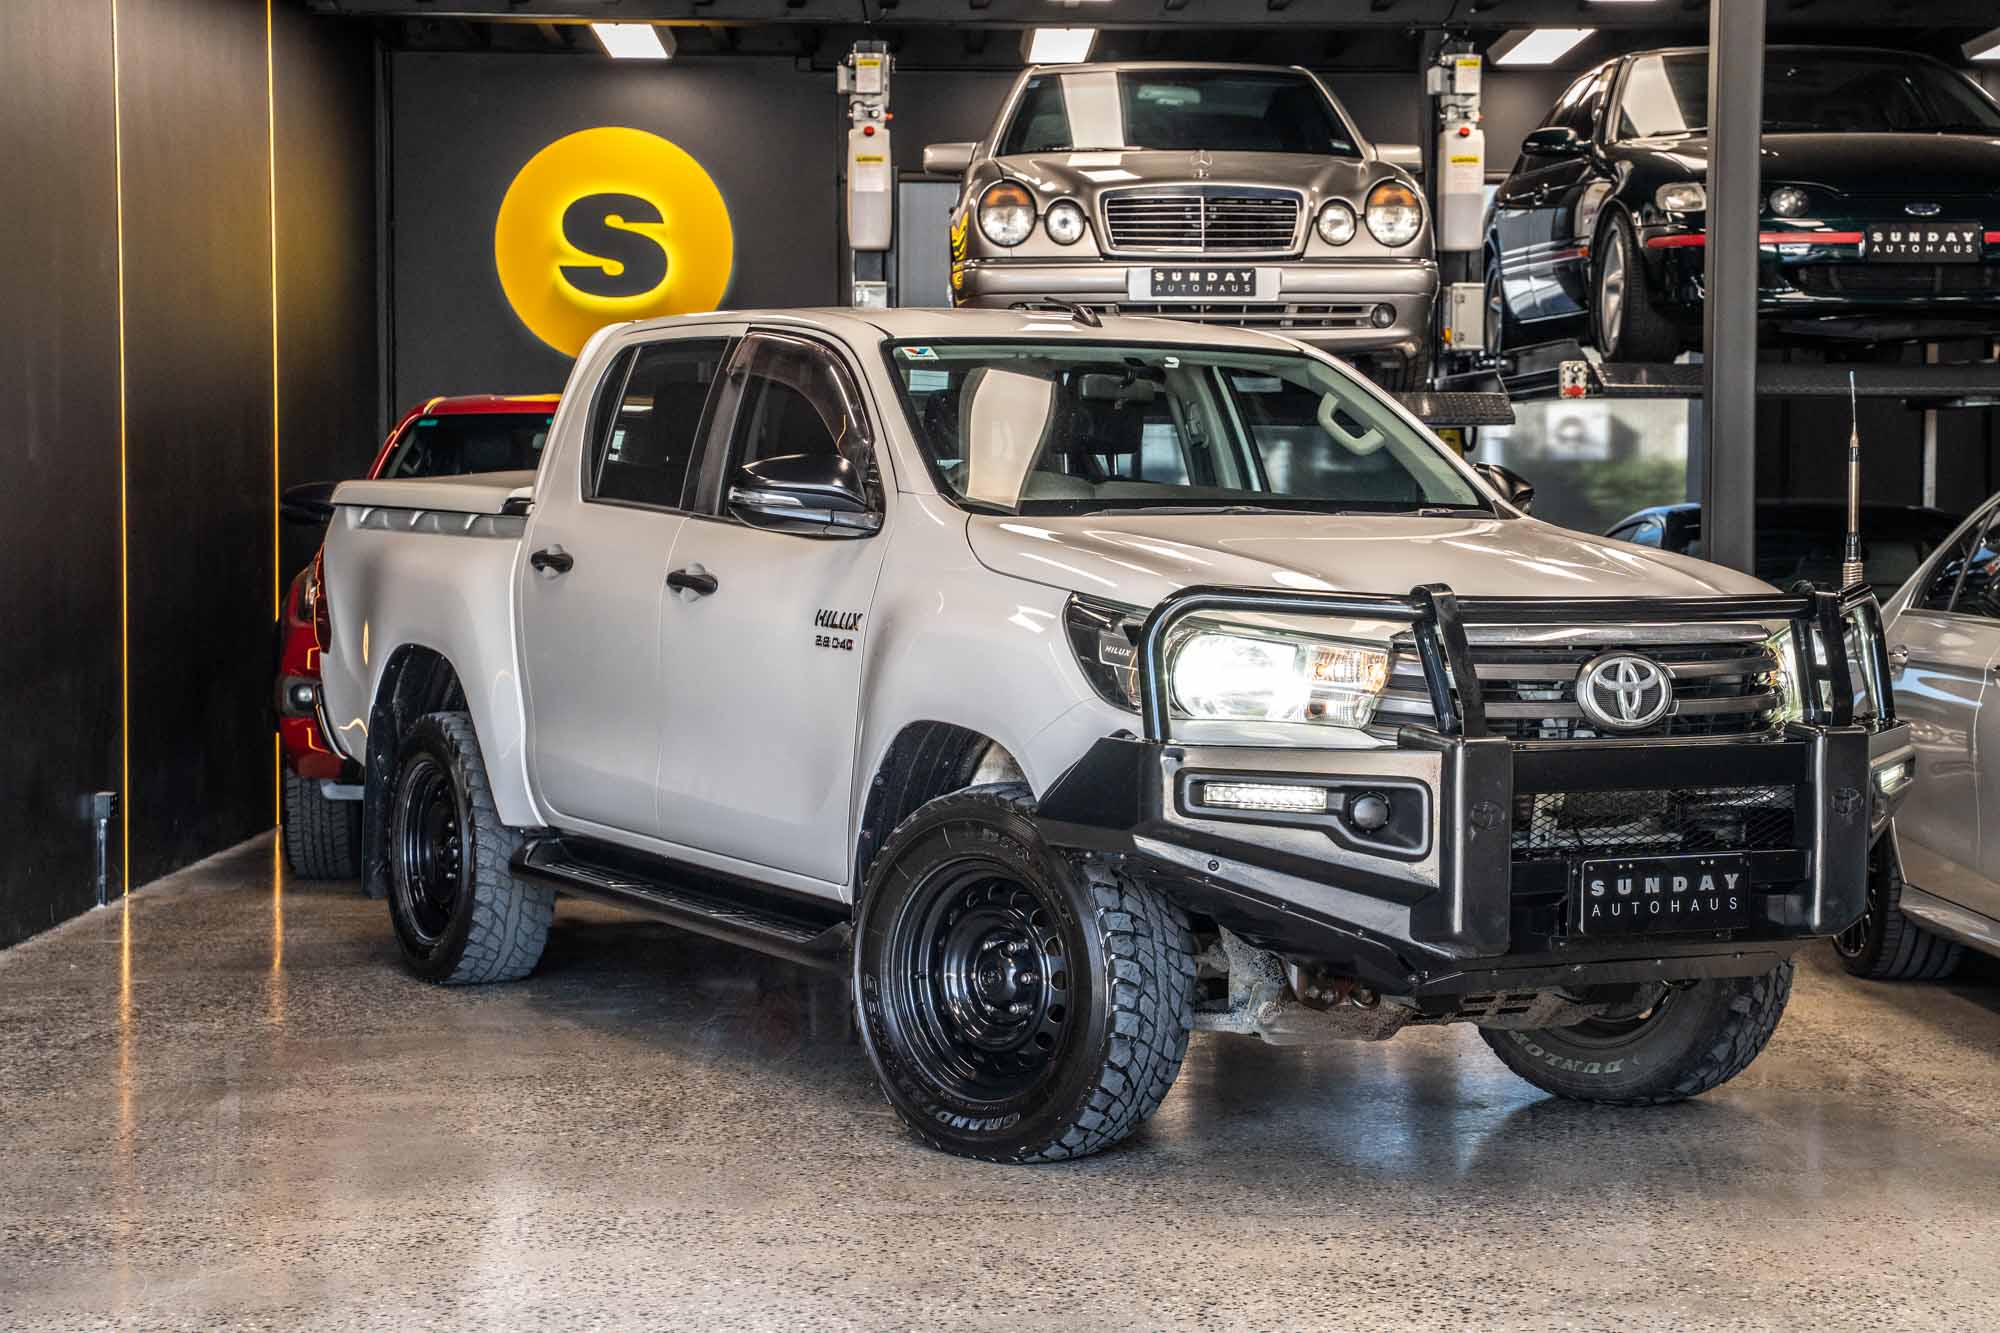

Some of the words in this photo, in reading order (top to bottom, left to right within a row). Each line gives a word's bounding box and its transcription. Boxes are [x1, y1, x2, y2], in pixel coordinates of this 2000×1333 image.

[559, 192, 668, 298] S
[1872, 231, 1974, 242] SUNDAY
[1873, 244, 1973, 253] AUTOHAUS
[1154, 271, 1252, 282] SUNDAY
[1155, 283, 1251, 293] AUTOHAUS
[815, 608, 863, 632] HILUX
[1104, 644, 1131, 657] HILUX
[1591, 873, 1739, 896] SUNDAY
[1591, 896, 1738, 917] AUTOHAUS
[934, 1110, 1022, 1132] GRAND
